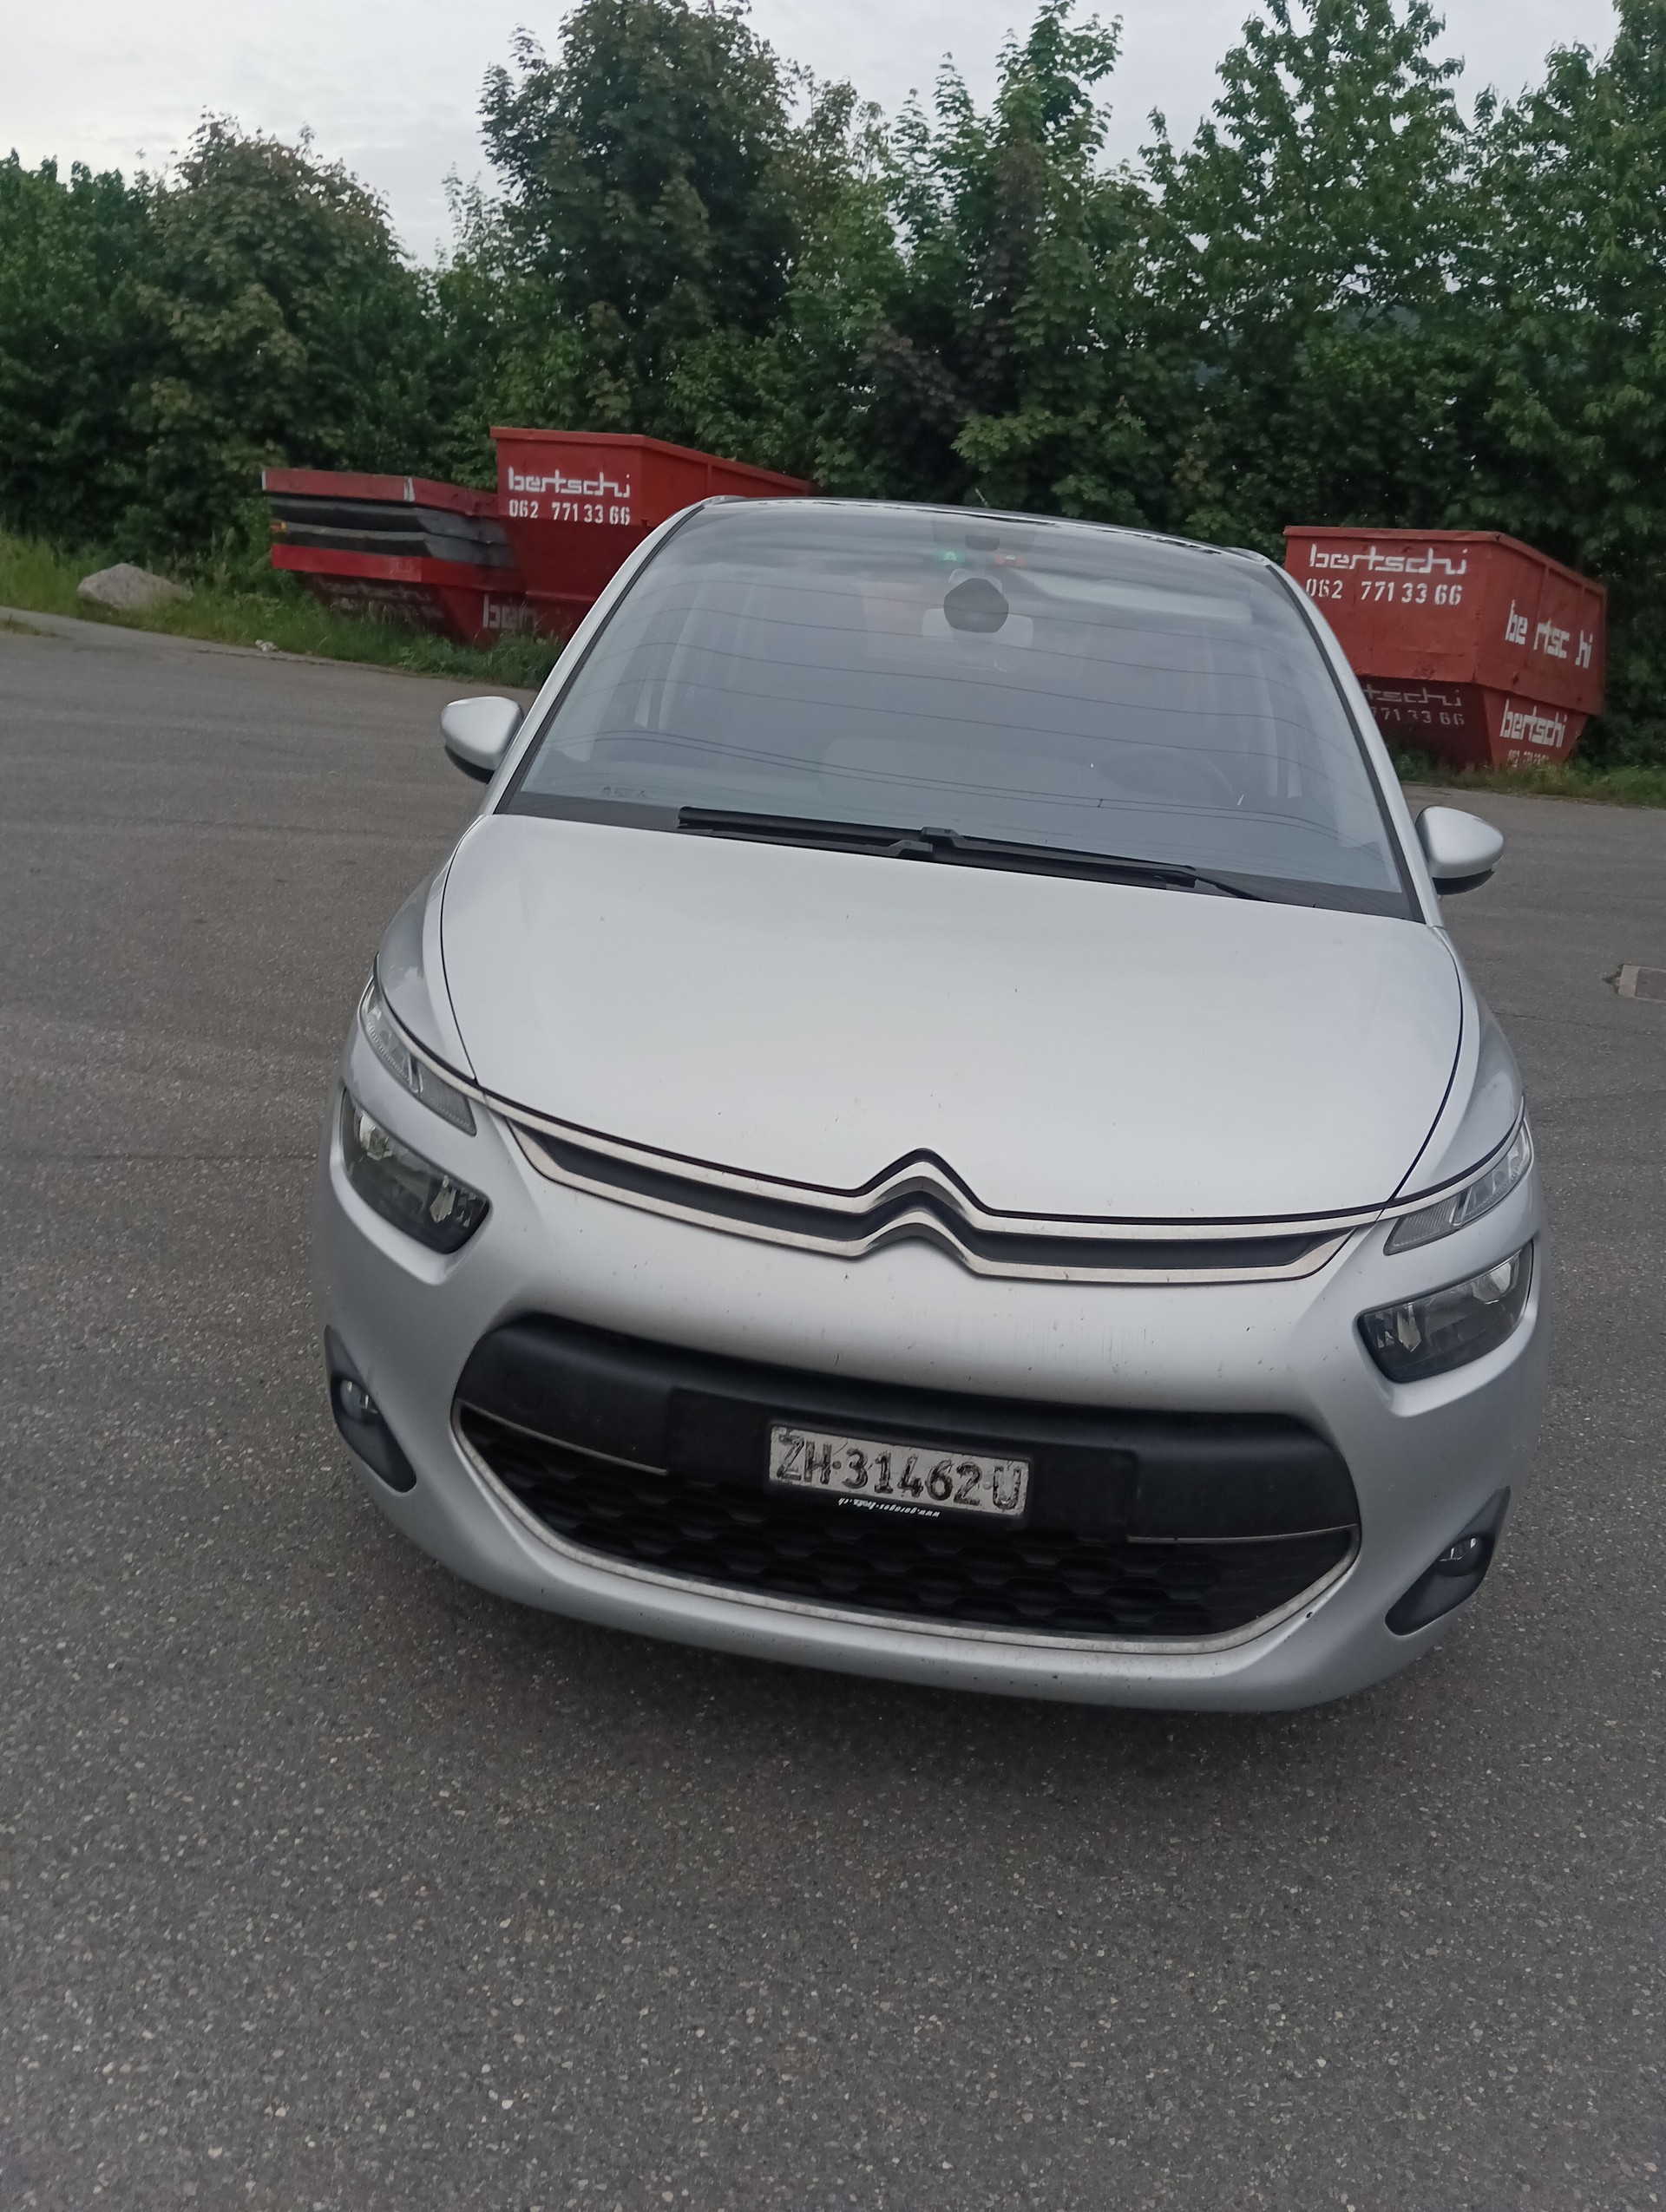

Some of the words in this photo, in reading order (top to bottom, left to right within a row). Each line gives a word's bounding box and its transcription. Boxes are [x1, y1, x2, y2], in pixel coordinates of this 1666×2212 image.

[508, 466, 630, 499] bertschi
[508, 500, 538, 519] 062
[553, 501, 579, 521] 771
[584, 504, 605, 524] 33
[609, 506, 630, 526] 66
[1309, 543, 1467, 575] bertschi
[1306, 579, 1343, 599] 062
[1361, 580, 1395, 602] 771
[1400, 582, 1427, 604] 33
[1434, 584, 1462, 605] 66
[1363, 684, 1462, 706] tschi
[1500, 698, 1567, 748] bertschi
